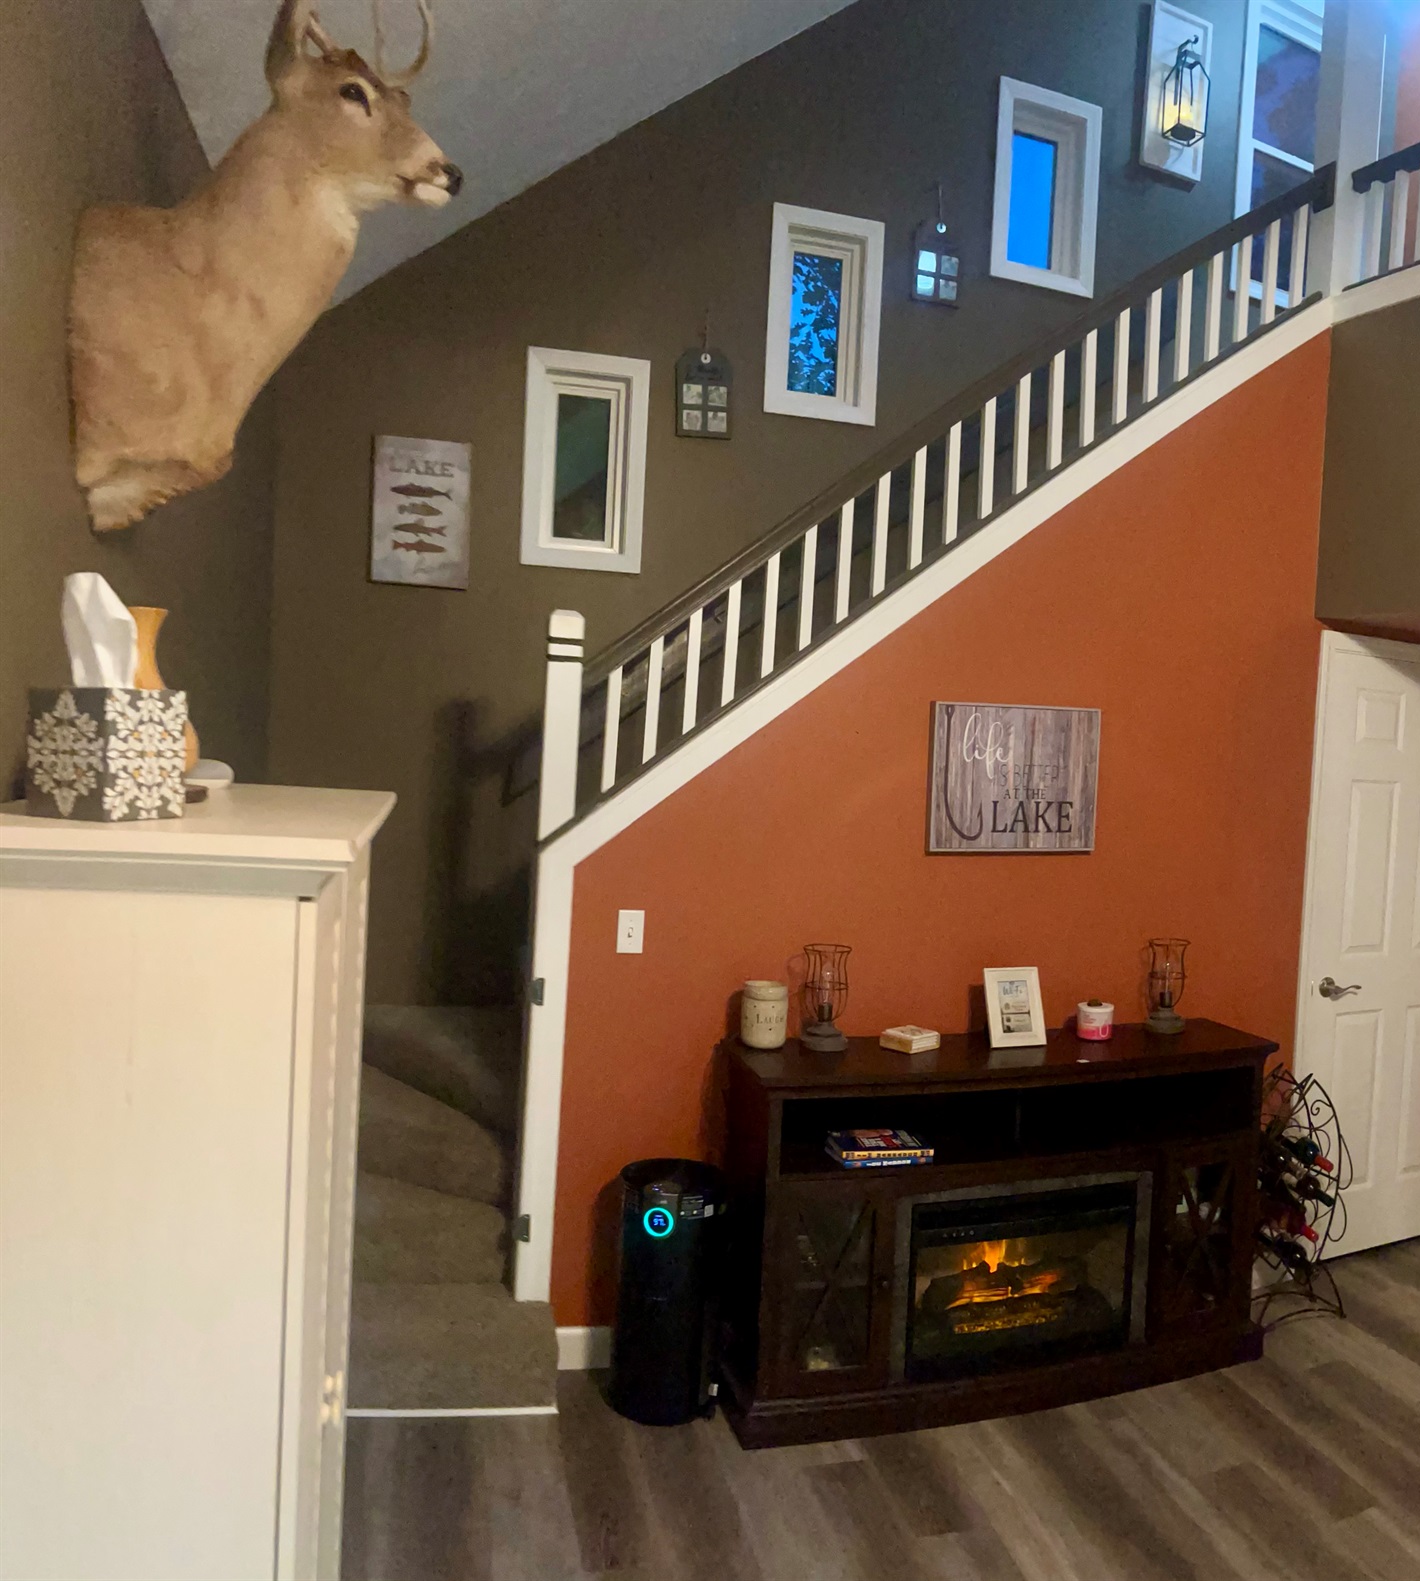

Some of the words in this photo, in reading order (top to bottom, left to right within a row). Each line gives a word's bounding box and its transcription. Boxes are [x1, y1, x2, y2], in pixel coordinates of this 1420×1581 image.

[389, 455, 455, 478] LAKE
[963, 712, 1010, 780] life
[1003, 788, 1020, 799] AT
[1023, 787, 1047, 800] THE
[990, 800, 1074, 833] LAKE
